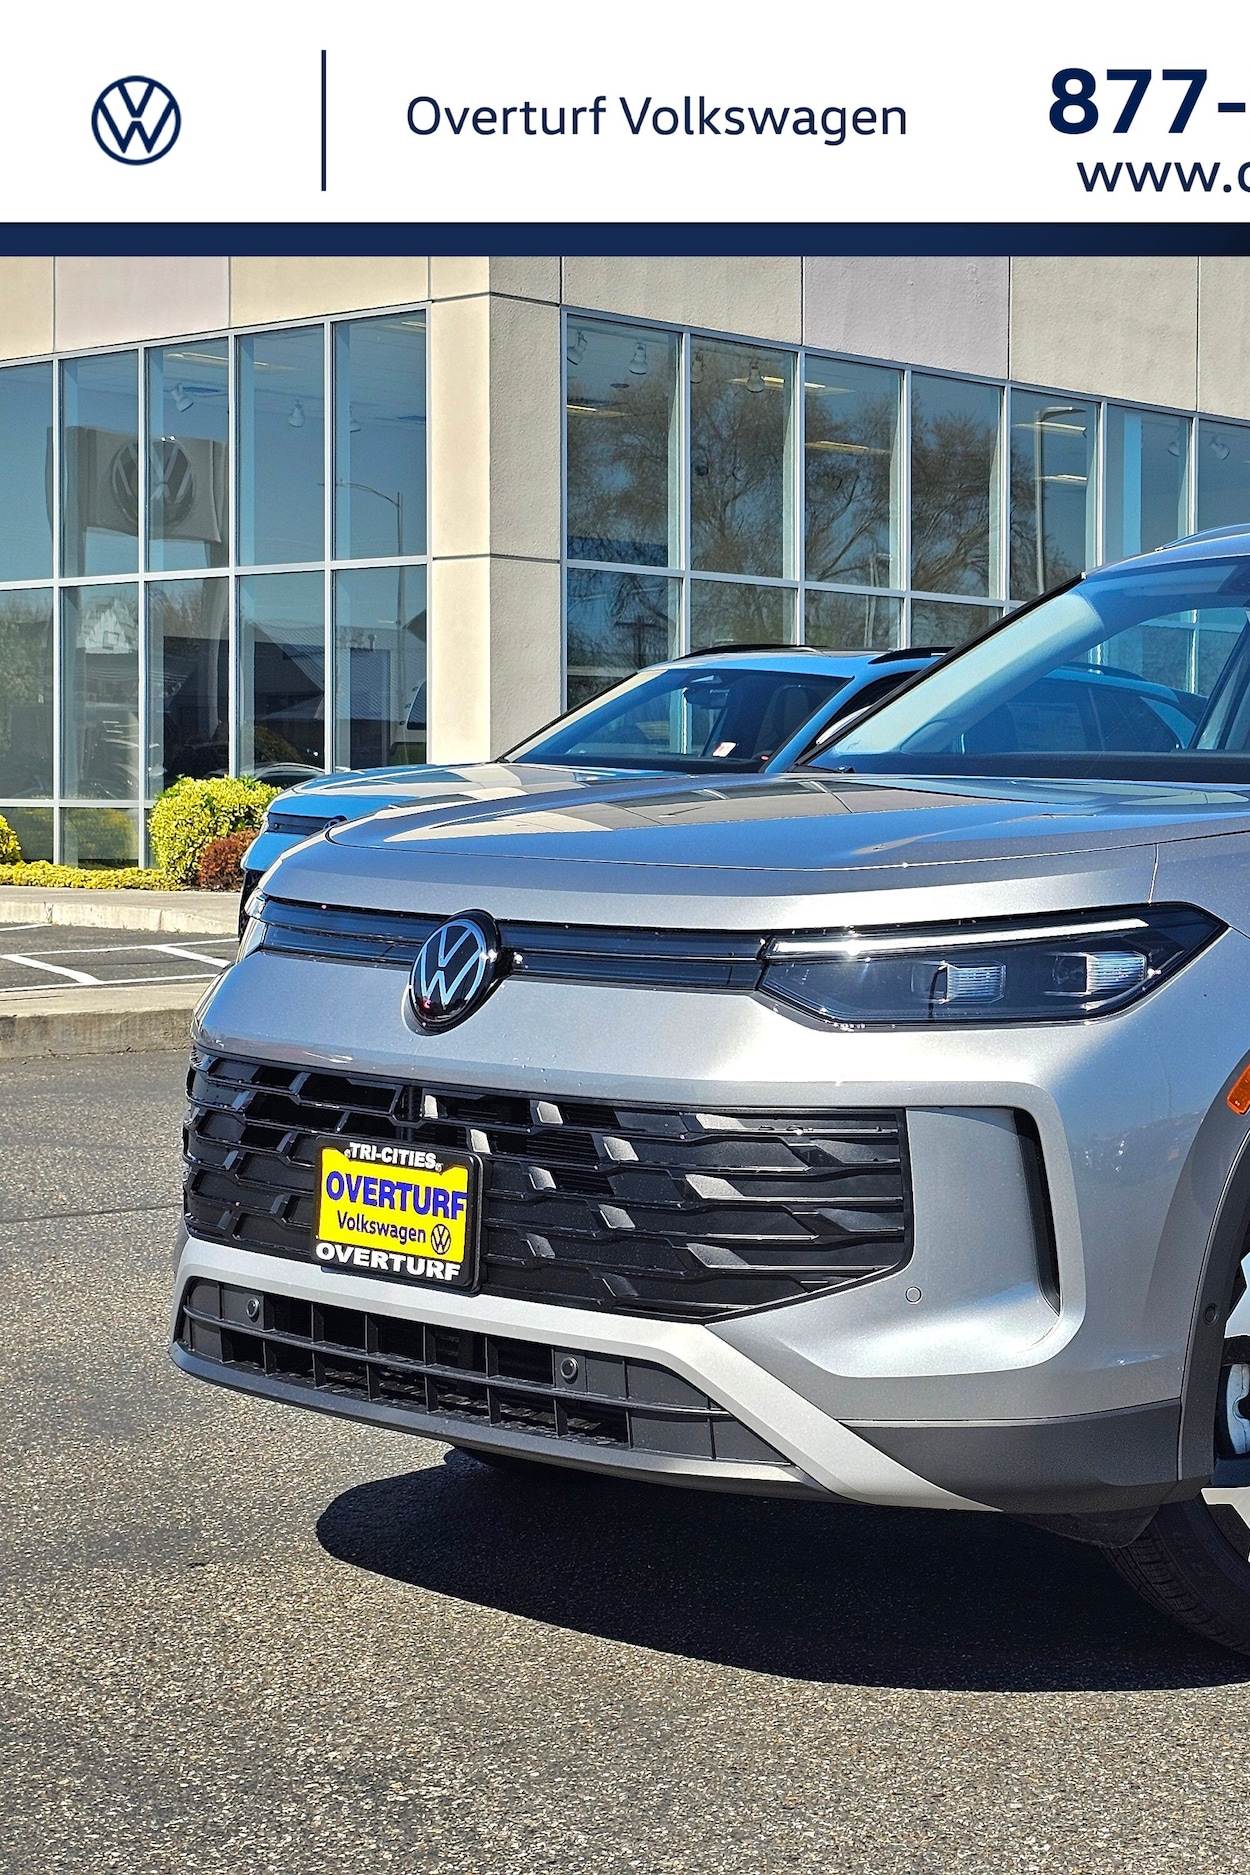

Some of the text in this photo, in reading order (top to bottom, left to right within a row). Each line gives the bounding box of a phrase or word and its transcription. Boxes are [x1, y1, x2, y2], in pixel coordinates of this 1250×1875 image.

[349, 1142, 436, 1170] TRI-CITIES
[326, 1171, 468, 1220] OVERTURF
[337, 1210, 426, 1245] Volkswagen
[315, 1242, 460, 1281] OVERTURF
